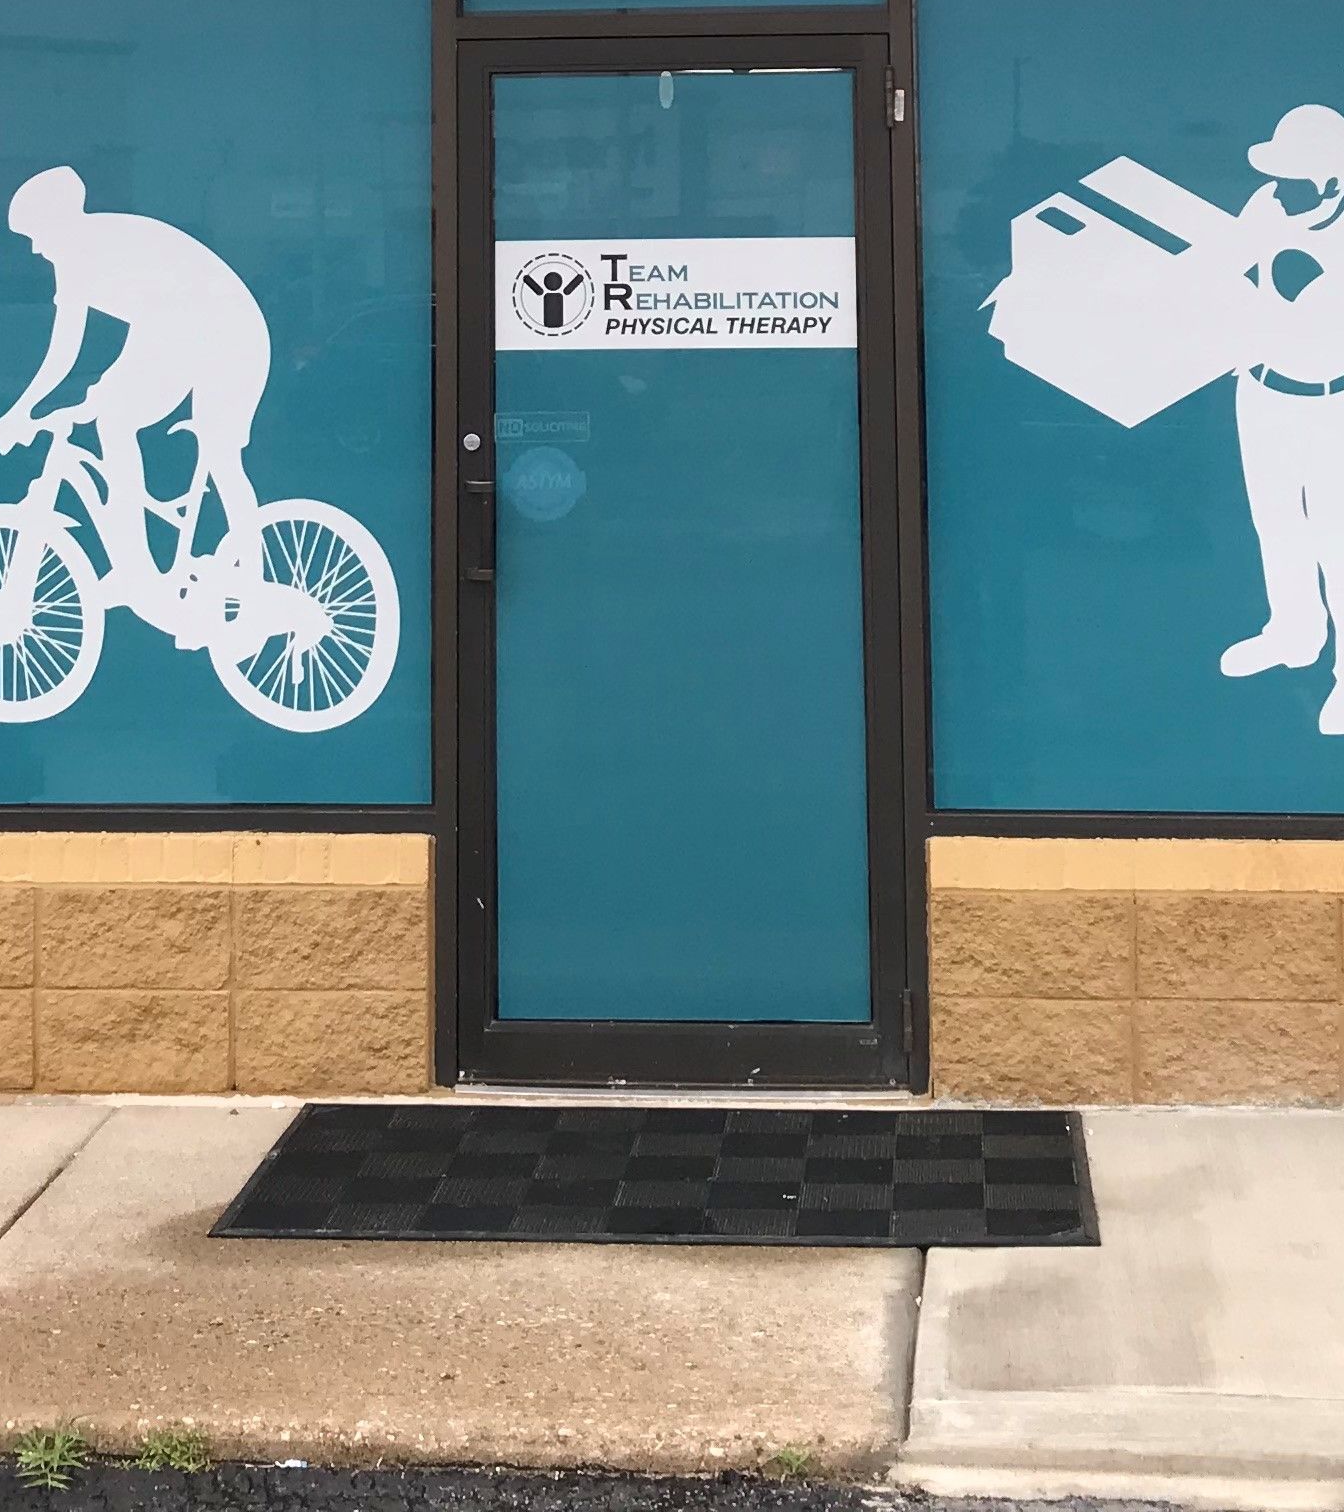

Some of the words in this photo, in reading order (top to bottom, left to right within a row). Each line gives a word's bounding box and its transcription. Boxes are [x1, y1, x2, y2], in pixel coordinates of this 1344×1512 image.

[605, 317, 718, 335] PHYSICAL
[726, 316, 832, 334] THERAPY
[498, 421, 522, 435] NO
